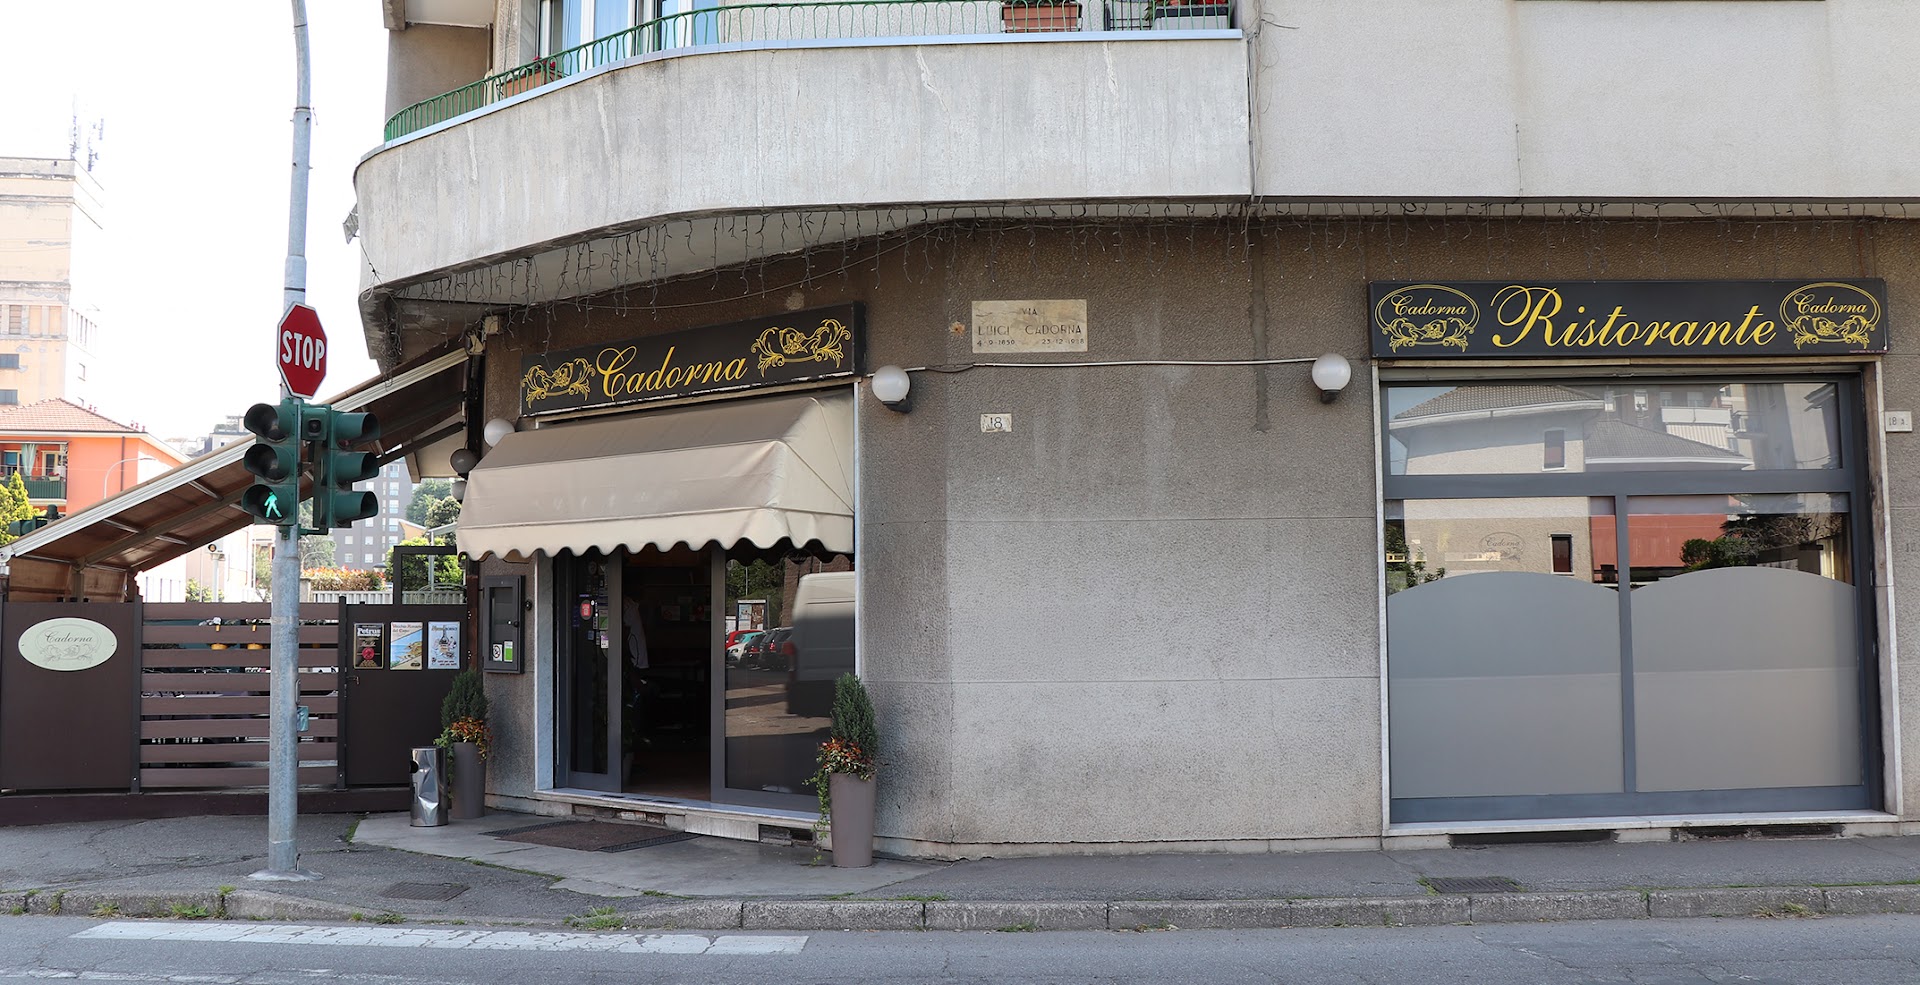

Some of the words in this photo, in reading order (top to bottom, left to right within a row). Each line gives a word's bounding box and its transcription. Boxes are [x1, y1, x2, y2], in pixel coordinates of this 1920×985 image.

[1390, 294, 1468, 316] Cadorna
[1793, 293, 1868, 315] Cadorna
[1021, 307, 1038, 316] VIA
[1490, 285, 1777, 348] Ristorante
[977, 325, 1011, 336] LUIGI
[1024, 324, 1082, 336] CADORNA
[281, 329, 325, 371] STOP
[596, 345, 748, 402] Cadorna
[990, 416, 1003, 429] 18
[1484, 536, 1520, 547] Cadorna
[44, 630, 93, 643] Cadorna
[357, 627, 381, 636] Petrus
